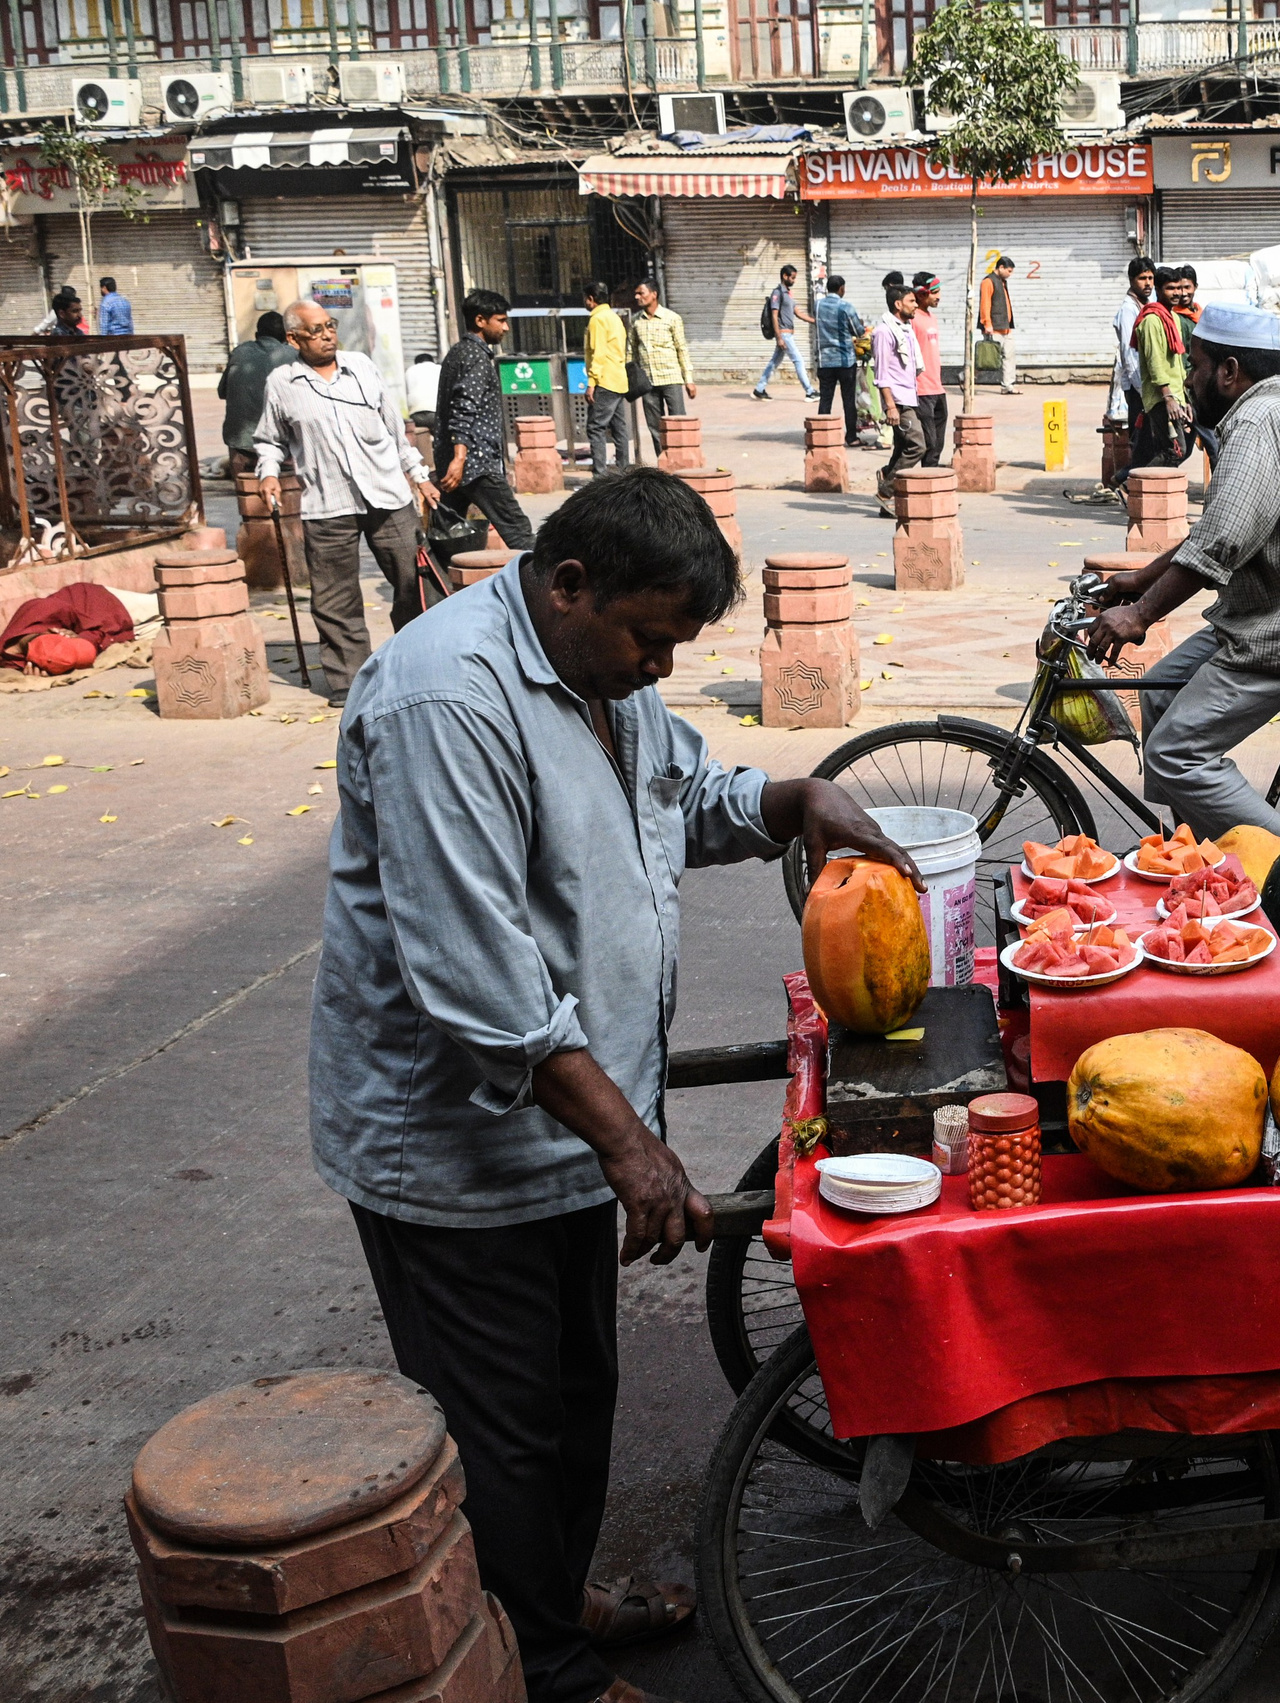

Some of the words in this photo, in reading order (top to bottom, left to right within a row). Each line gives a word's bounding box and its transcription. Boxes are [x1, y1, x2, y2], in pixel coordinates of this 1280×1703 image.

[806, 152, 920, 183] SHIVAM
[1037, 148, 1148, 179] HOUSE
[881, 183, 908, 192] Deals
[911, 183, 921, 192] In
[1021, 180, 1059, 190] Fabrics
[1026, 261, 1041, 279] 2
